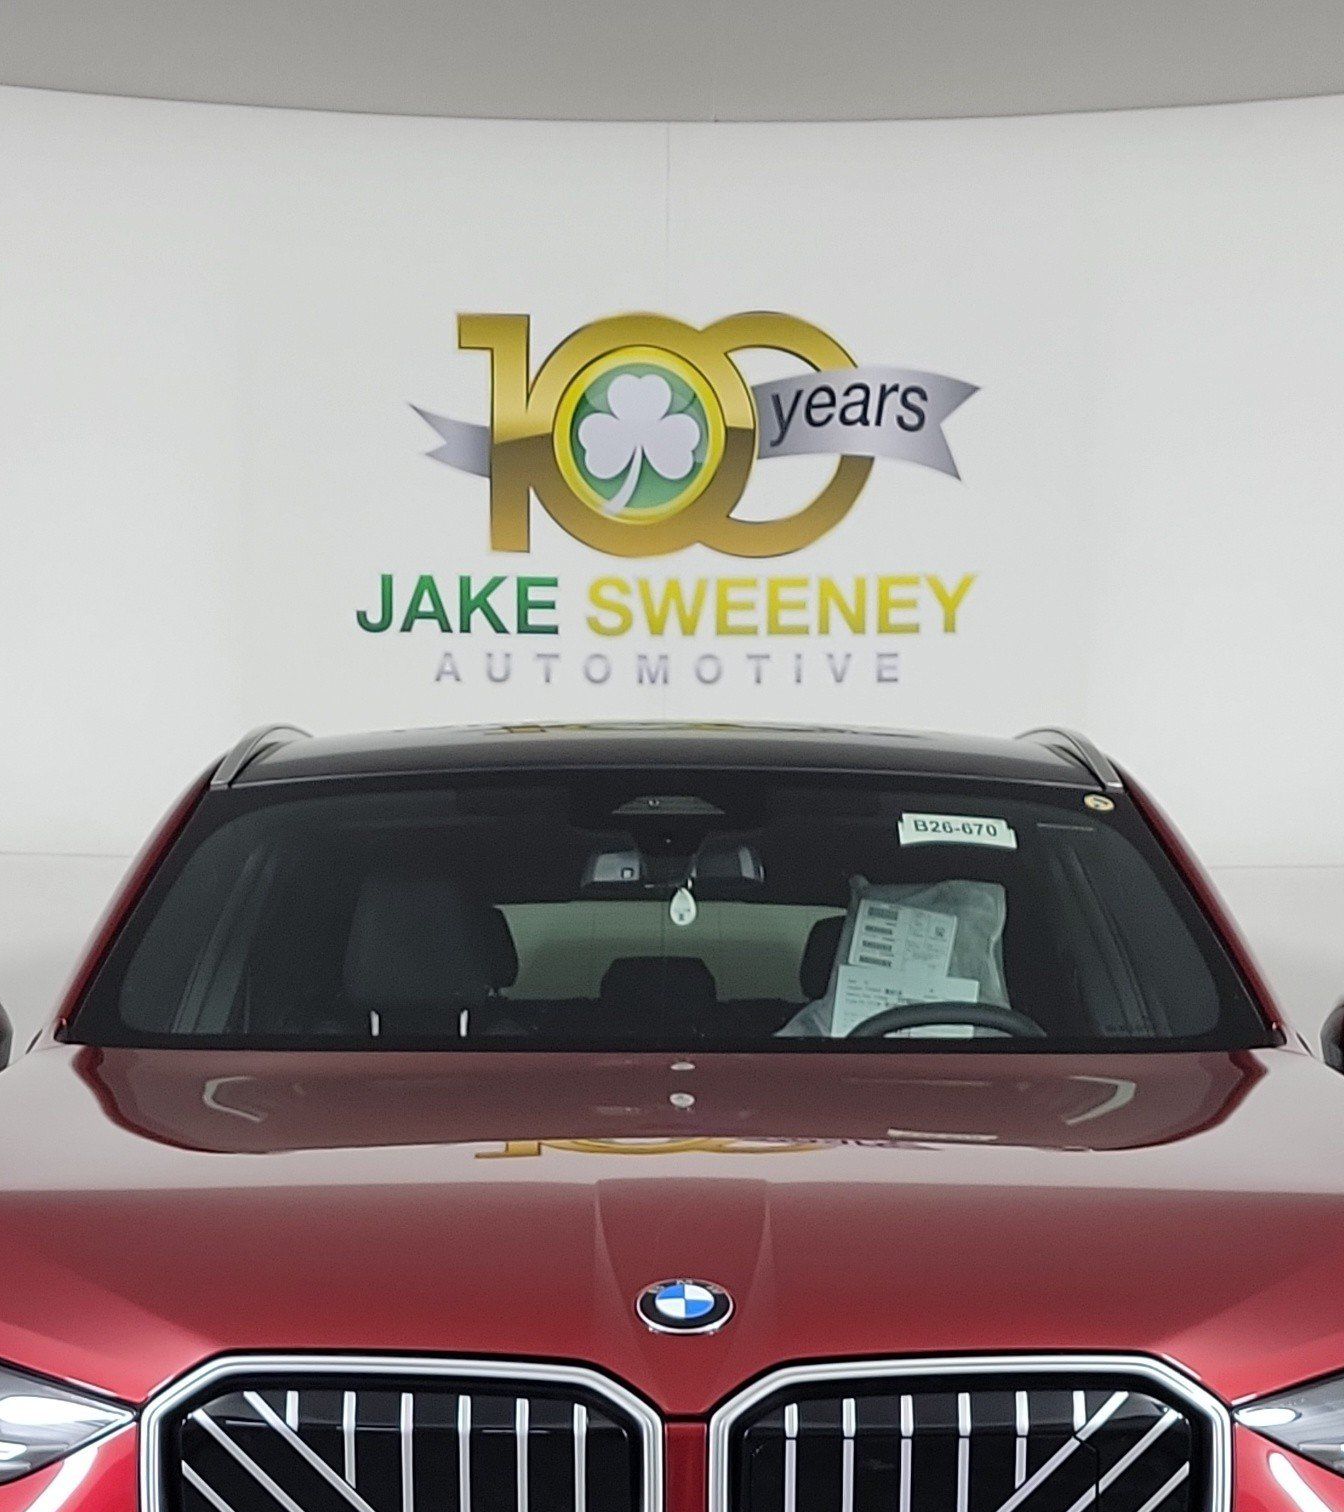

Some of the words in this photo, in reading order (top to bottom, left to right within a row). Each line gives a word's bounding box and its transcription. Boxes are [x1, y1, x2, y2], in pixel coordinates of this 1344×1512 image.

[458, 310, 874, 558] 100
[770, 381, 928, 447] years
[356, 573, 560, 635] JAKE
[586, 573, 976, 637] SWEENEY
[434, 651, 902, 686] AUTOMOTIVE
[914, 819, 998, 837] B26-670
